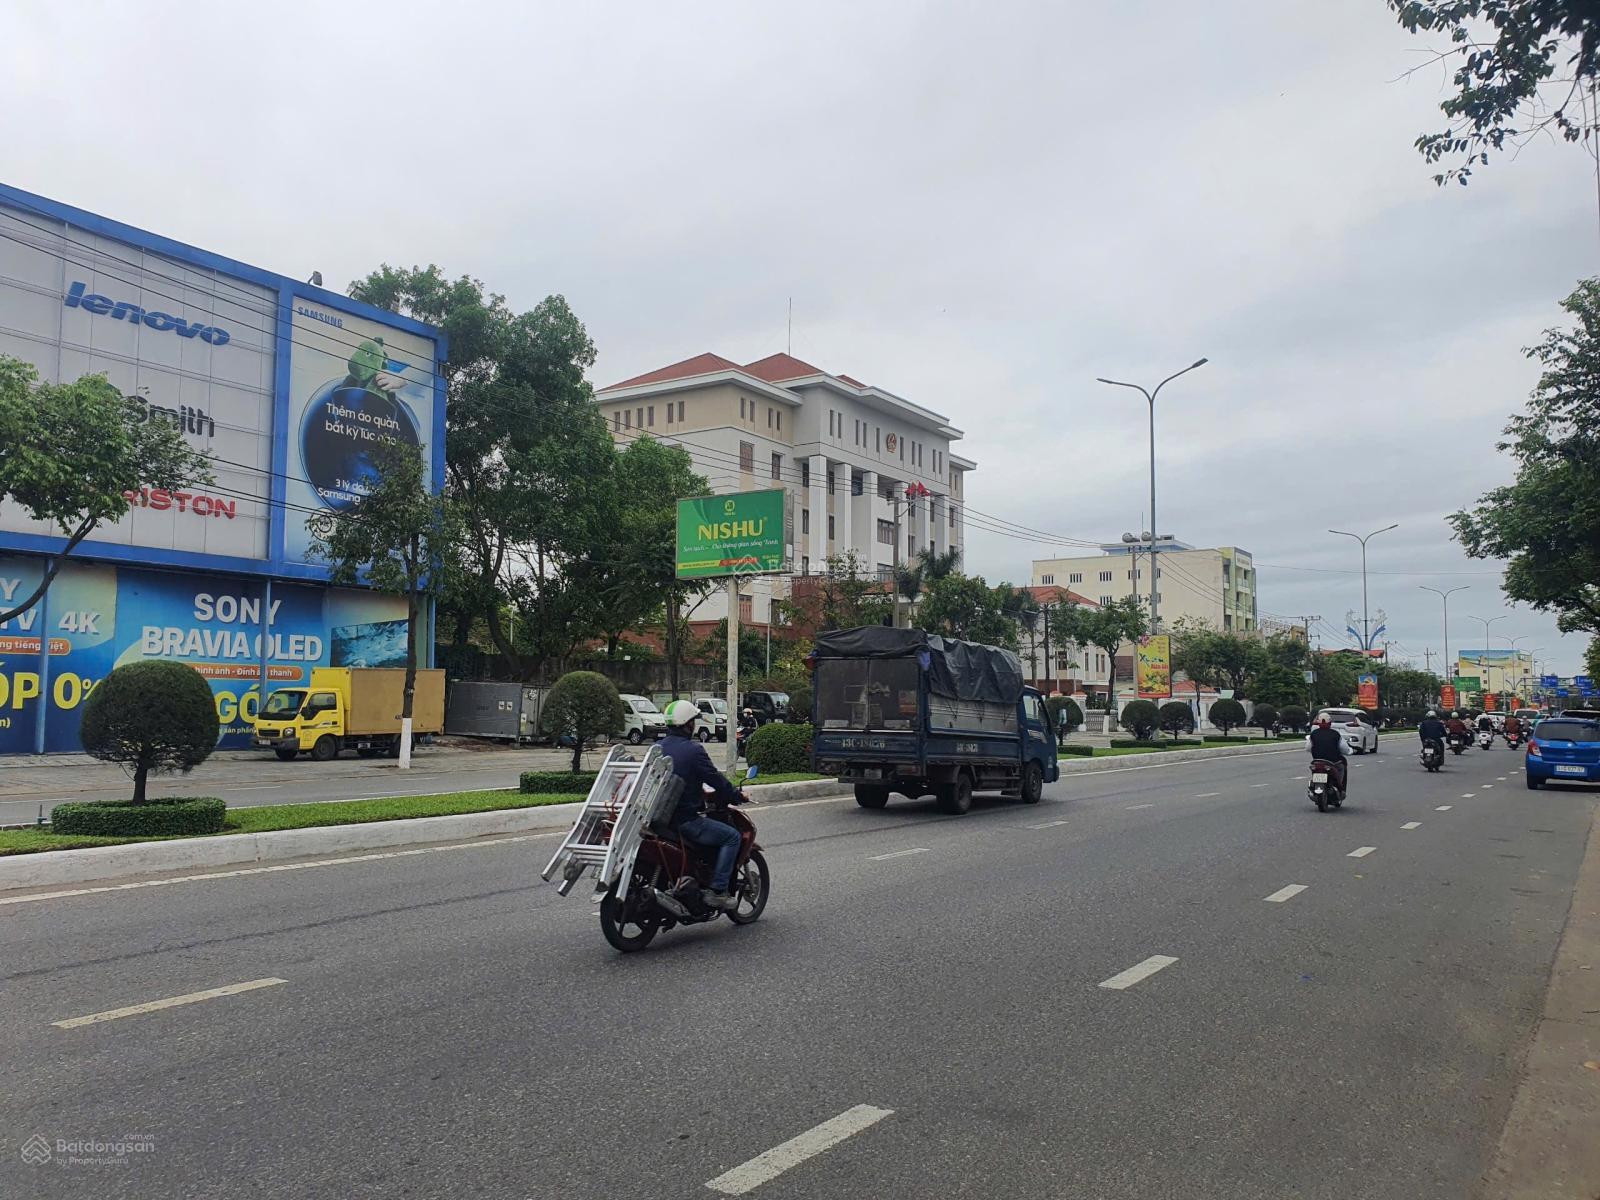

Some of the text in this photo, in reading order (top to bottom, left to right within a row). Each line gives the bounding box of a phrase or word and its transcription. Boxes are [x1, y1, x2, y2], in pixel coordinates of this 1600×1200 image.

[64, 281, 230, 346] lenovo
[297, 306, 343, 328] SAMSUNG
[326, 402, 356, 419] Thêm
[358, 410, 372, 423] áo
[325, 420, 345, 434] bất
[346, 425, 358, 441] kỳ
[335, 479, 341, 488] 3
[122, 487, 236, 520] RISTON
[318, 487, 361, 506] Samsung
[698, 519, 763, 541] NISHU
[193, 593, 282, 625] SONY
[58, 610, 102, 635] 4K
[142, 626, 323, 662] BRAVIA OLED
[270, 669, 292, 677] thanh
